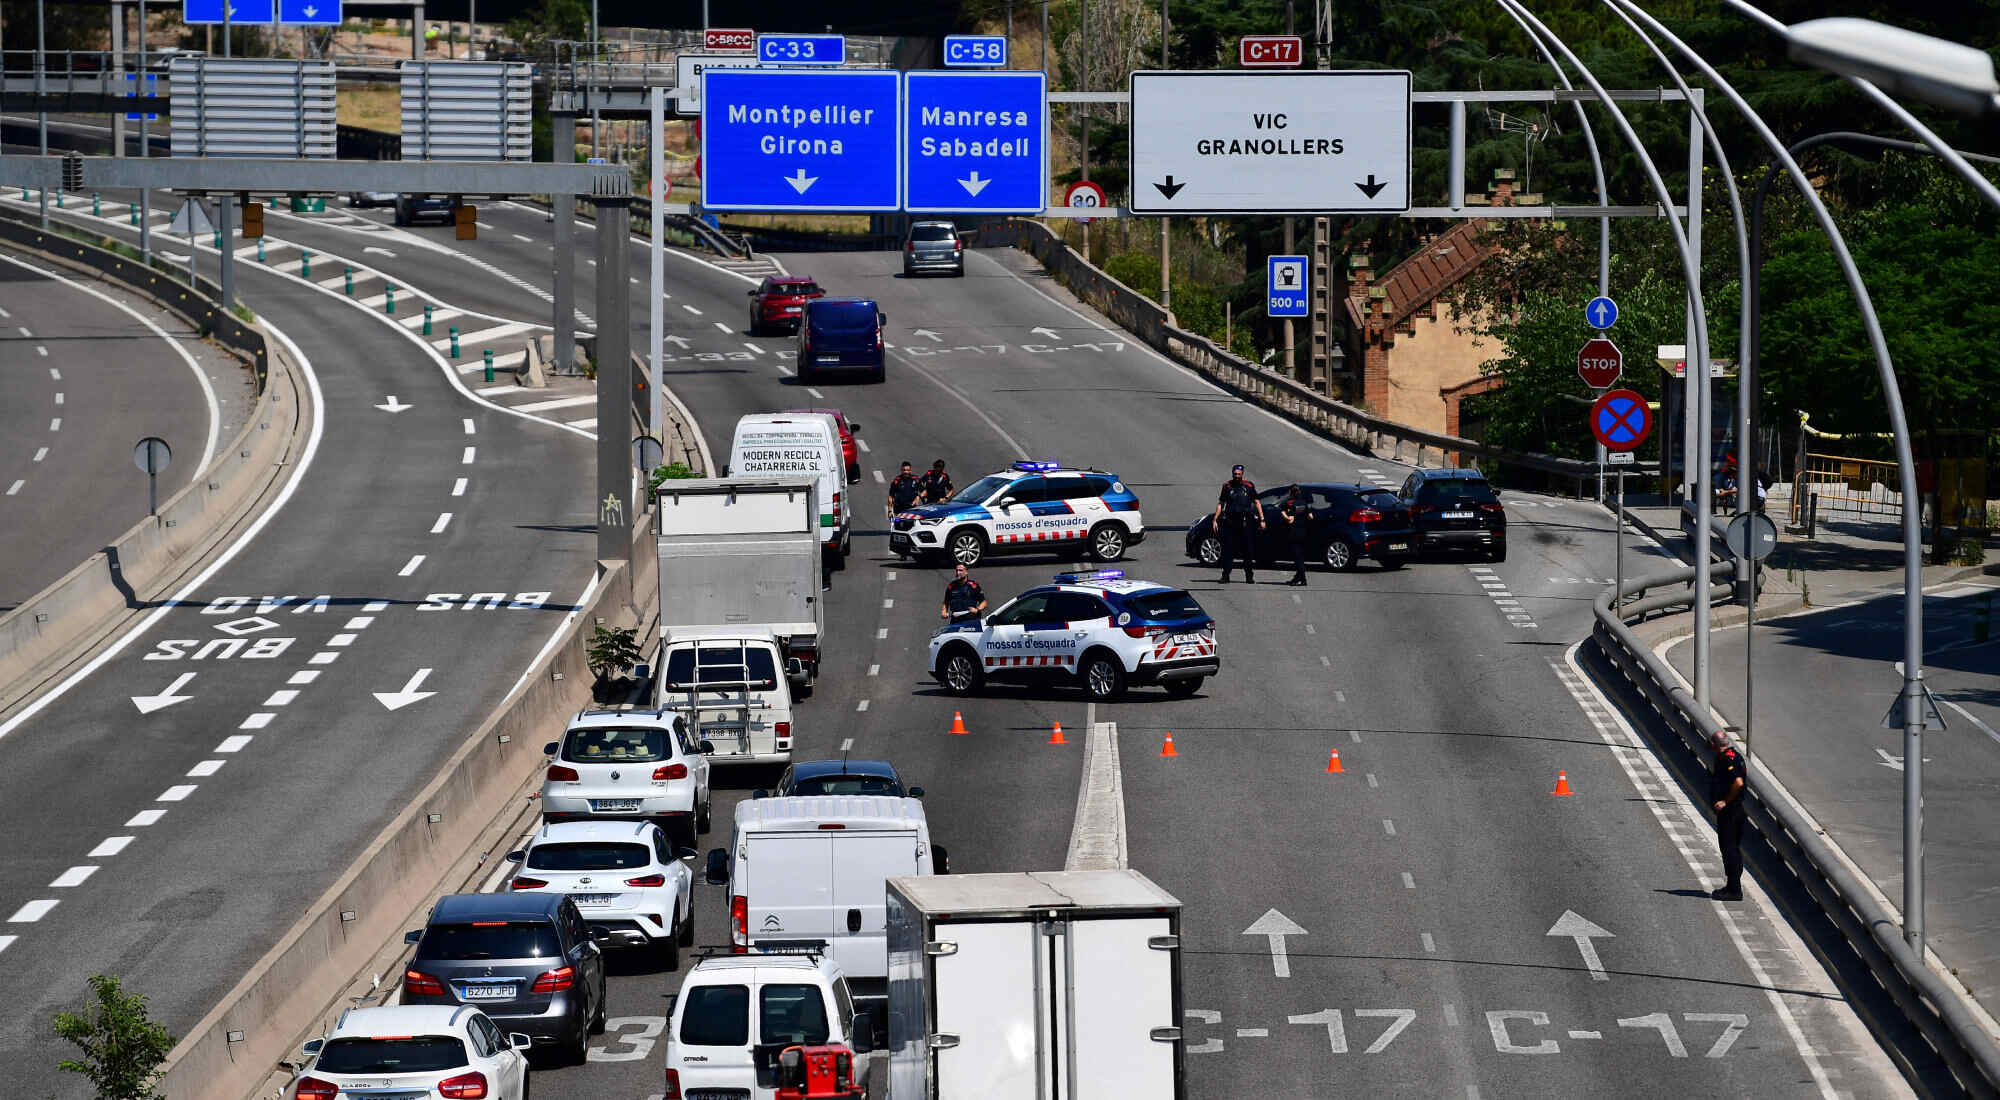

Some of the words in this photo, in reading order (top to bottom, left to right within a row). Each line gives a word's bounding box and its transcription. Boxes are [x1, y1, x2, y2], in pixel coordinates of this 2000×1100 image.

[765, 41, 815, 58] C-33
[950, 43, 1001, 59] C-58
[1250, 43, 1292, 59] C-17
[728, 104, 875, 128] Montpellier
[921, 106, 1028, 126] Manresa
[1253, 113, 1288, 129] VIC
[760, 135, 843, 154] Girona
[920, 137, 1029, 157] Sabadell
[1197, 138, 1344, 155] GRANOLLERS
[1271, 297, 1293, 308] 500
[1296, 299, 1305, 308] m
[904, 344, 1005, 355] C-17
[1020, 342, 1125, 353] C-17
[1582, 358, 1617, 370] STOP
[743, 450, 780, 461] MODERN
[784, 450, 821, 461] RECICLA
[809, 461, 821, 471] SL
[995, 521, 1033, 531] mossos
[1035, 516, 1088, 530] d'esquadra
[200, 595, 331, 614] VAO
[416, 591, 552, 611] BUS
[143, 637, 296, 661] BUS
[986, 640, 1022, 650] mossos
[1024, 638, 1077, 651] d'esquadra
[468, 986, 493, 996] 6270
[496, 985, 514, 996] JPD
[1485, 1010, 1750, 1058] C-17
